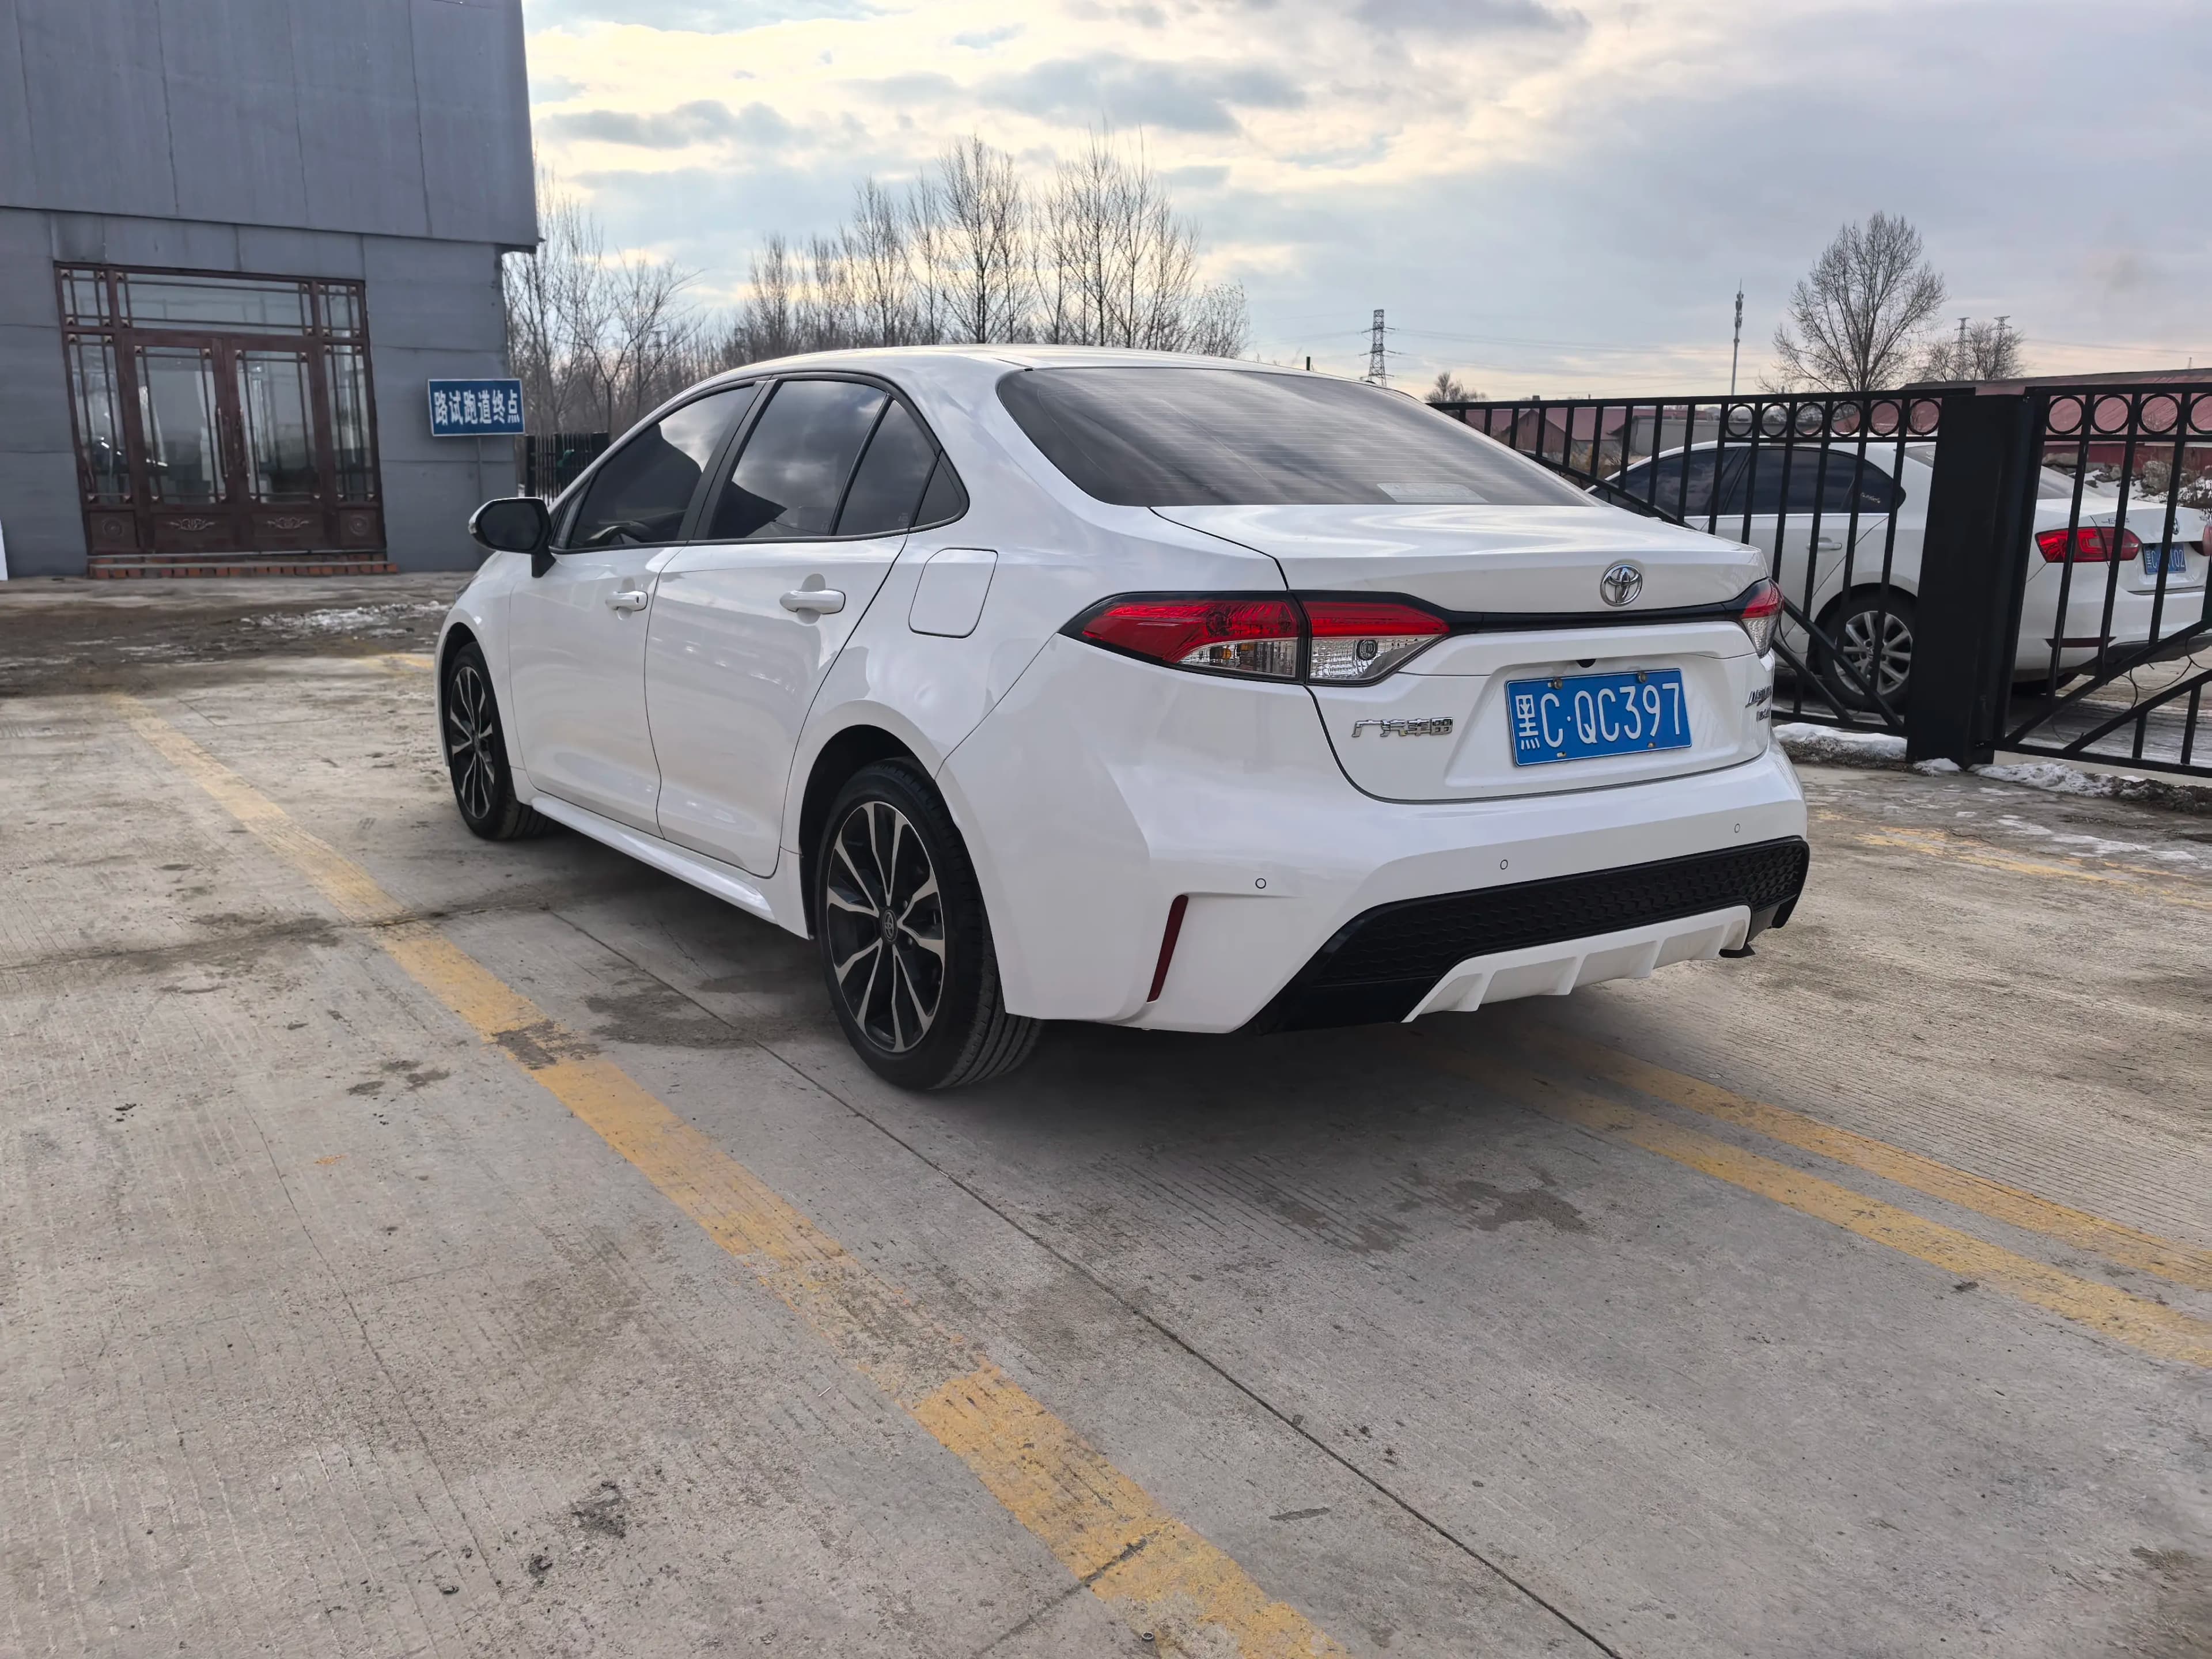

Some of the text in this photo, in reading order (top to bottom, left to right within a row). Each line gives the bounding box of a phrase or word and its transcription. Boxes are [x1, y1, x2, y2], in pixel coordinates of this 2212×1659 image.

[434, 389, 520, 425] 路试跑道终点
[1352, 717, 1453, 738] 广汽丰田
